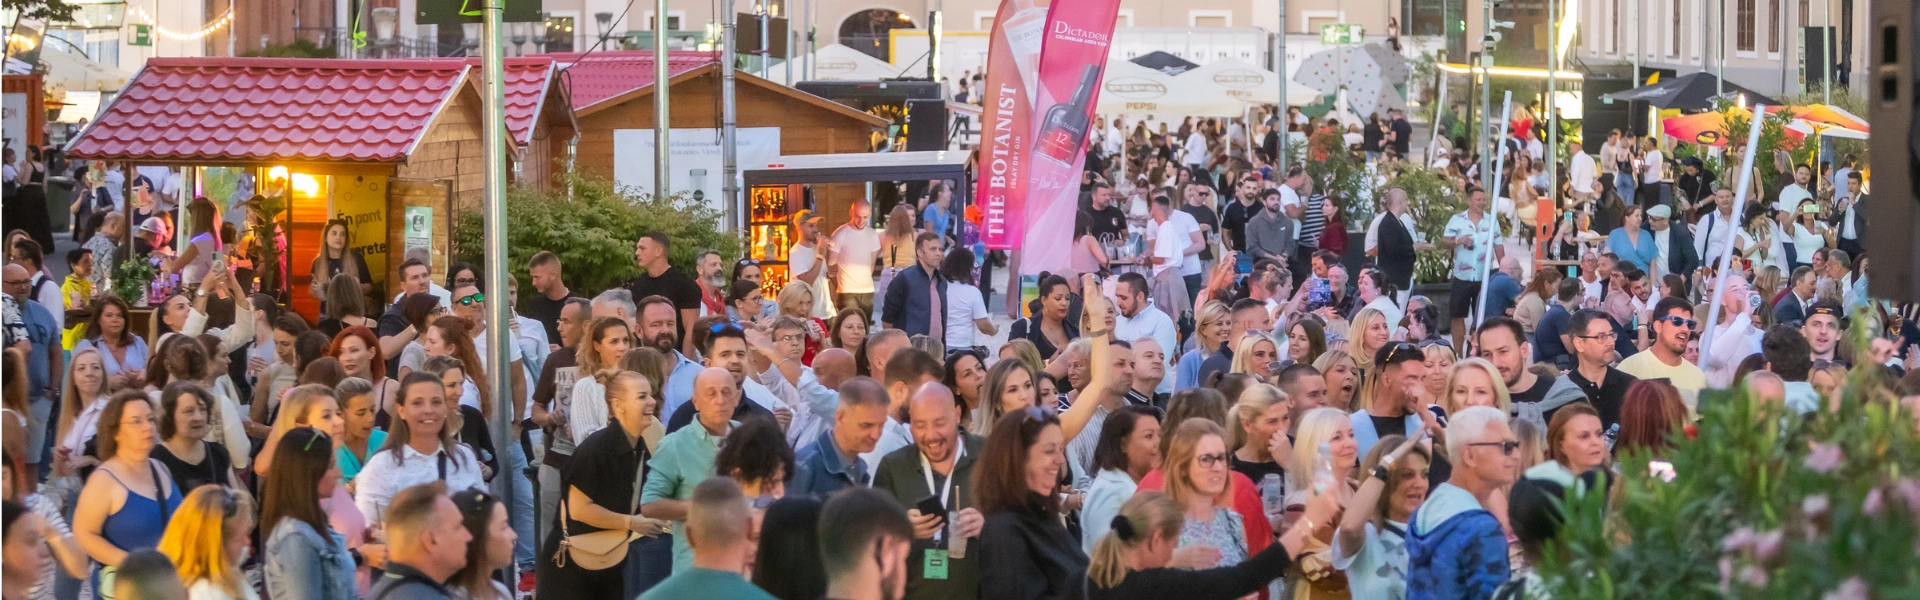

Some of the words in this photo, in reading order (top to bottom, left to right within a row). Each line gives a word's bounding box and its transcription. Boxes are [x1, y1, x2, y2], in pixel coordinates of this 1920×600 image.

[1226, 89, 1252, 97] PEPI
[1126, 102, 1157, 110] PEPSI
[990, 83, 1017, 189] BOTANIST
[1055, 132, 1068, 145] 12
[1010, 168, 1018, 189] ISLAY
[355, 209, 383, 228] pont
[988, 194, 1005, 238] THE
